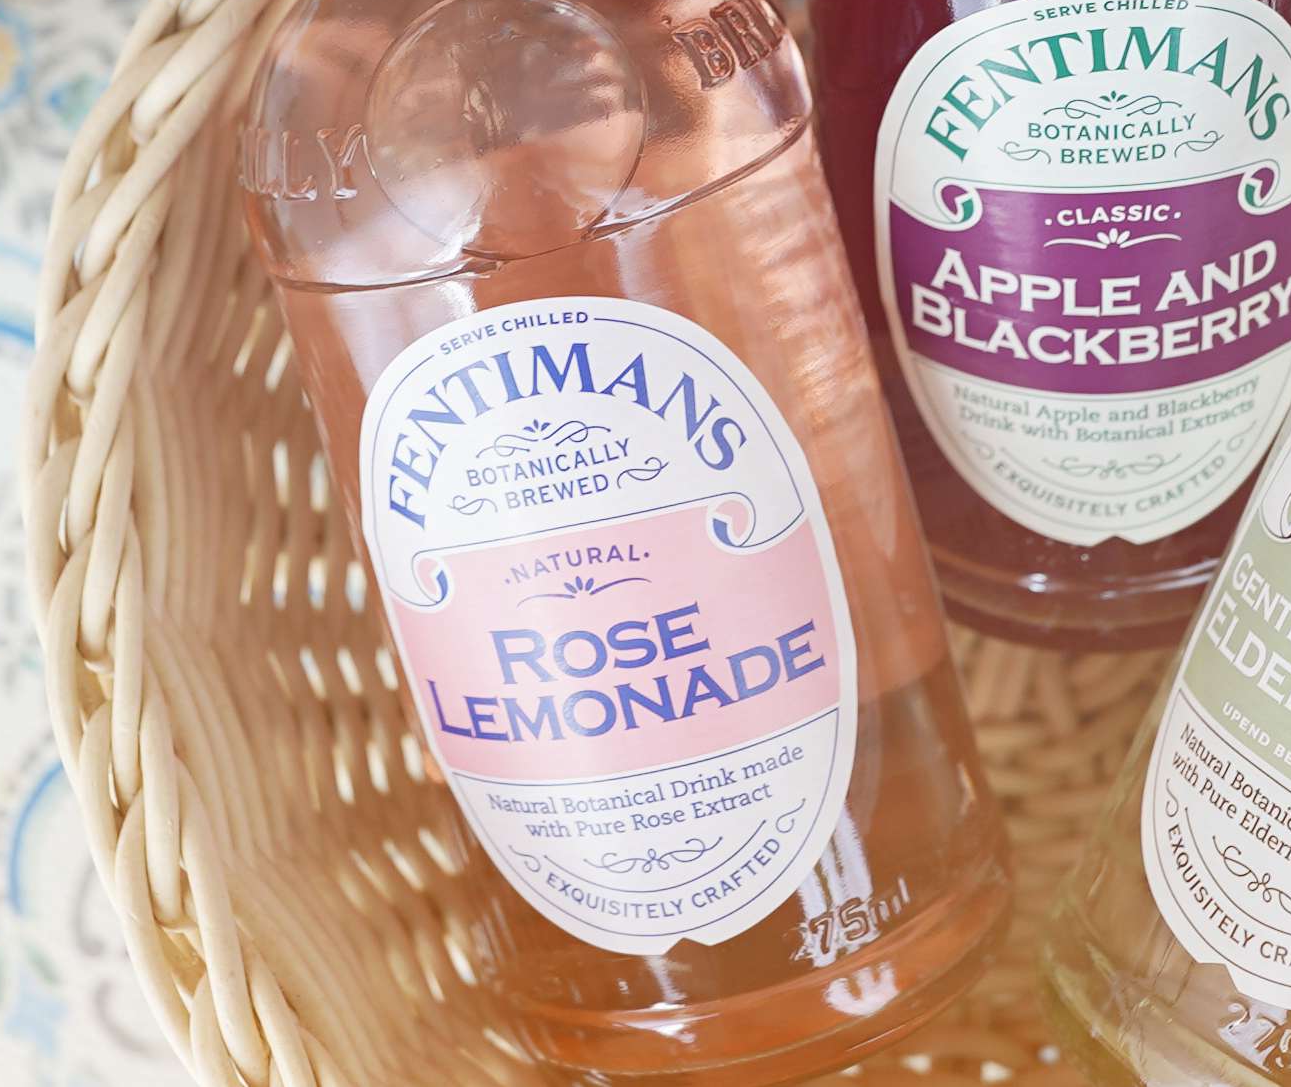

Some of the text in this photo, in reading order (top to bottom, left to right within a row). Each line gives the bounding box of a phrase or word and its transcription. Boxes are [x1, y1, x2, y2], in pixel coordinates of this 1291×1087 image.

[1033, 1, 1096, 21] SERVE
[923, 25, 1290, 161] FENTIMANS
[1028, 113, 1196, 140] BOTANICALLY
[1060, 143, 1167, 164] BREWED
[931, 239, 1277, 317] APPLE AND
[440, 311, 589, 356] SERVE CHILLED
[953, 376, 1260, 428] Natural Apple and Blackberry
[958, 398, 1255, 443] Drink with Botanical Extracts
[388, 342, 748, 530] FENTIMANS
[466, 437, 631, 487] BOTANICALLY
[504, 473, 609, 510] BREWED
[994, 454, 1226, 516] EXQUISITELY CRAFTED
[489, 601, 710, 685] ROSE
[427, 620, 826, 743] LEMONADE
[1179, 724, 1231, 775] Natural
[1223, 702, 1269, 746] UPEND
[486, 743, 805, 815] Natural Botanical Drink made
[1171, 753, 1206, 791] with
[1198, 781, 1238, 819] Pure
[525, 782, 773, 840] with Pure Rose Extract
[547, 837, 782, 919] EXQUISITELY CRAFTED
[1167, 826, 1253, 949] EXQUISITELY
